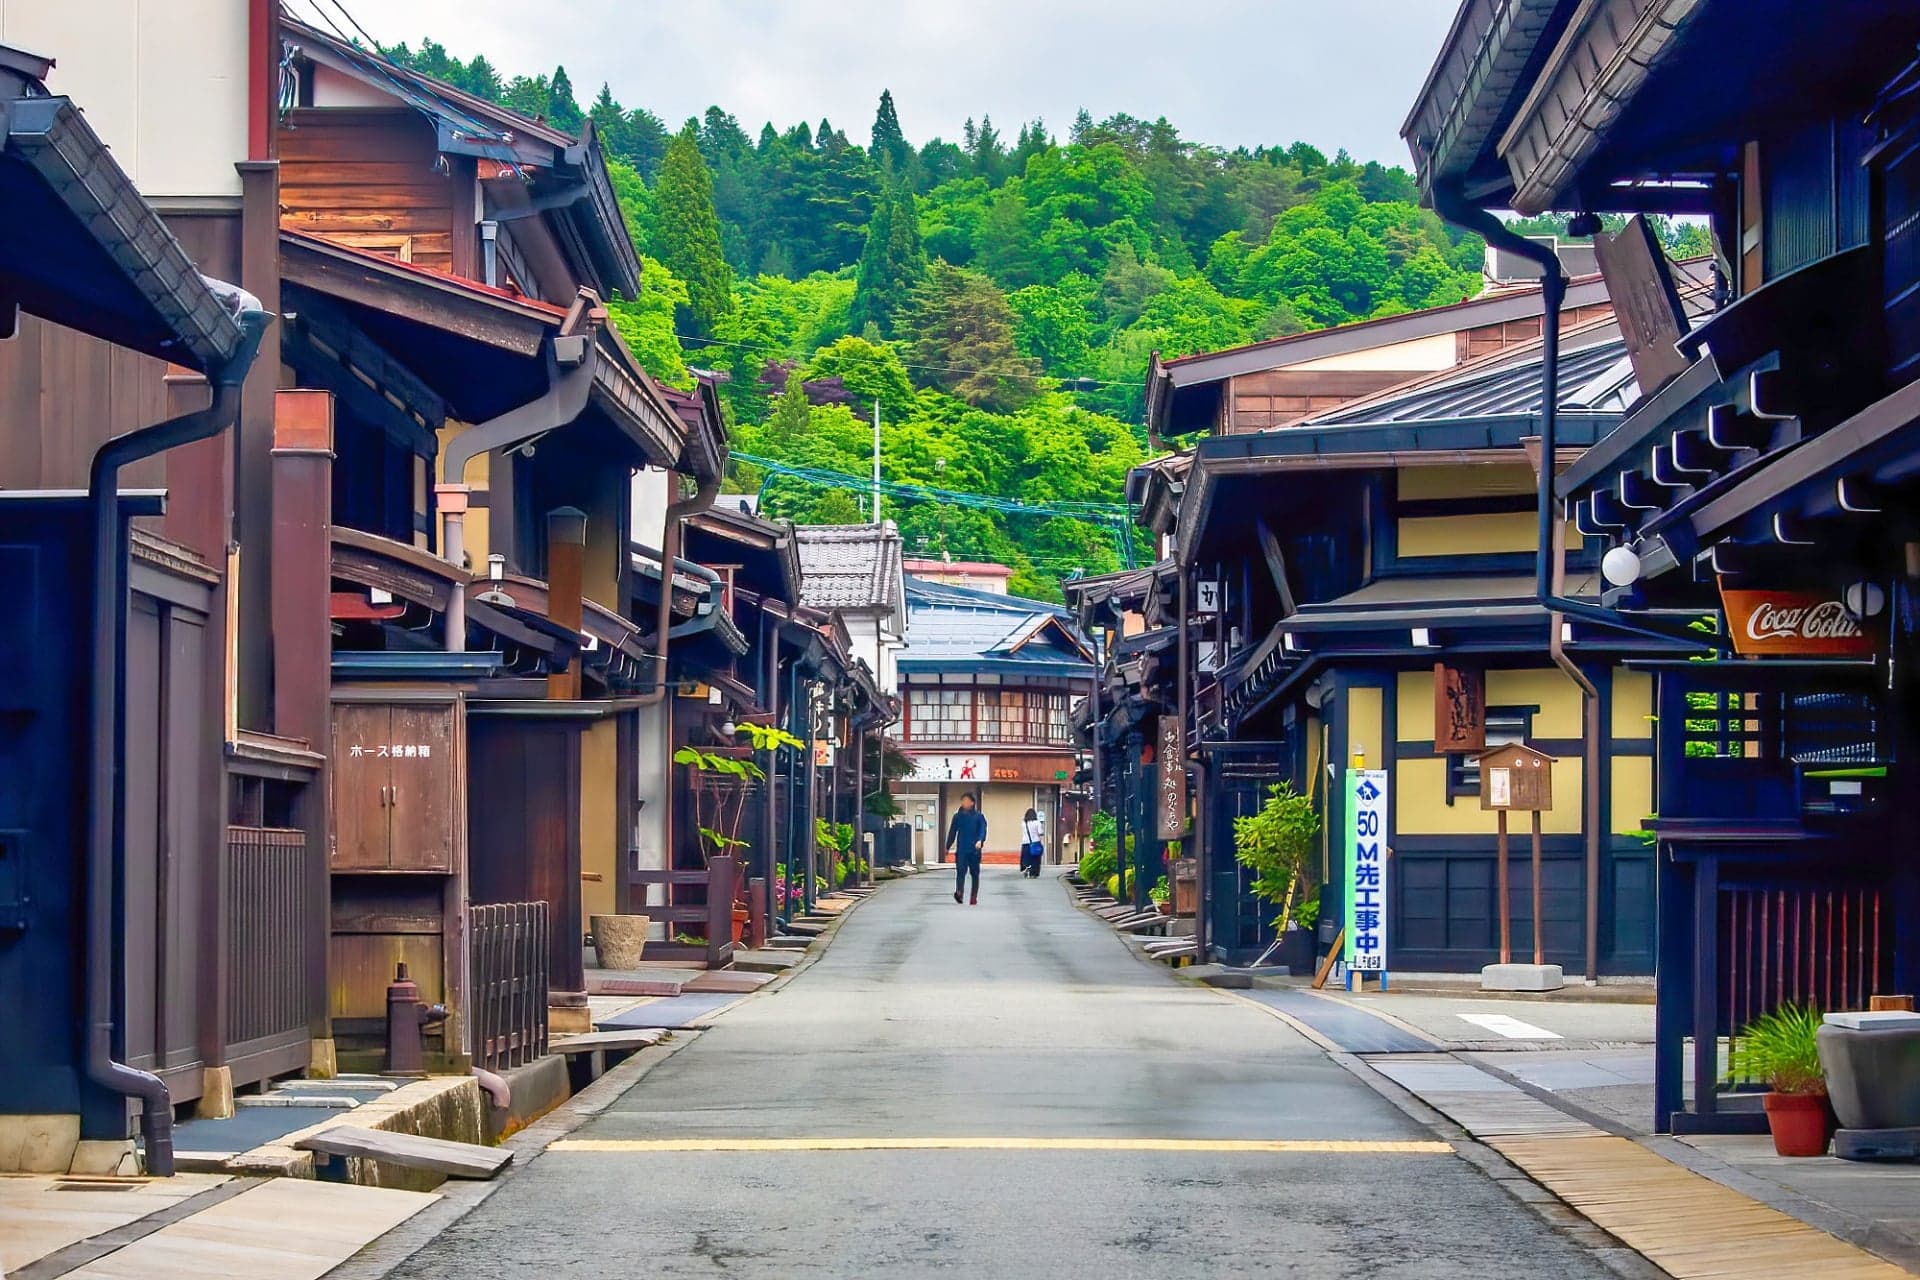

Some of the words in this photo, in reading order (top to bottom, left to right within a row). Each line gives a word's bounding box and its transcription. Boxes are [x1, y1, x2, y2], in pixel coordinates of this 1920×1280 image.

[350, 744, 431, 758] ホース格納箱
